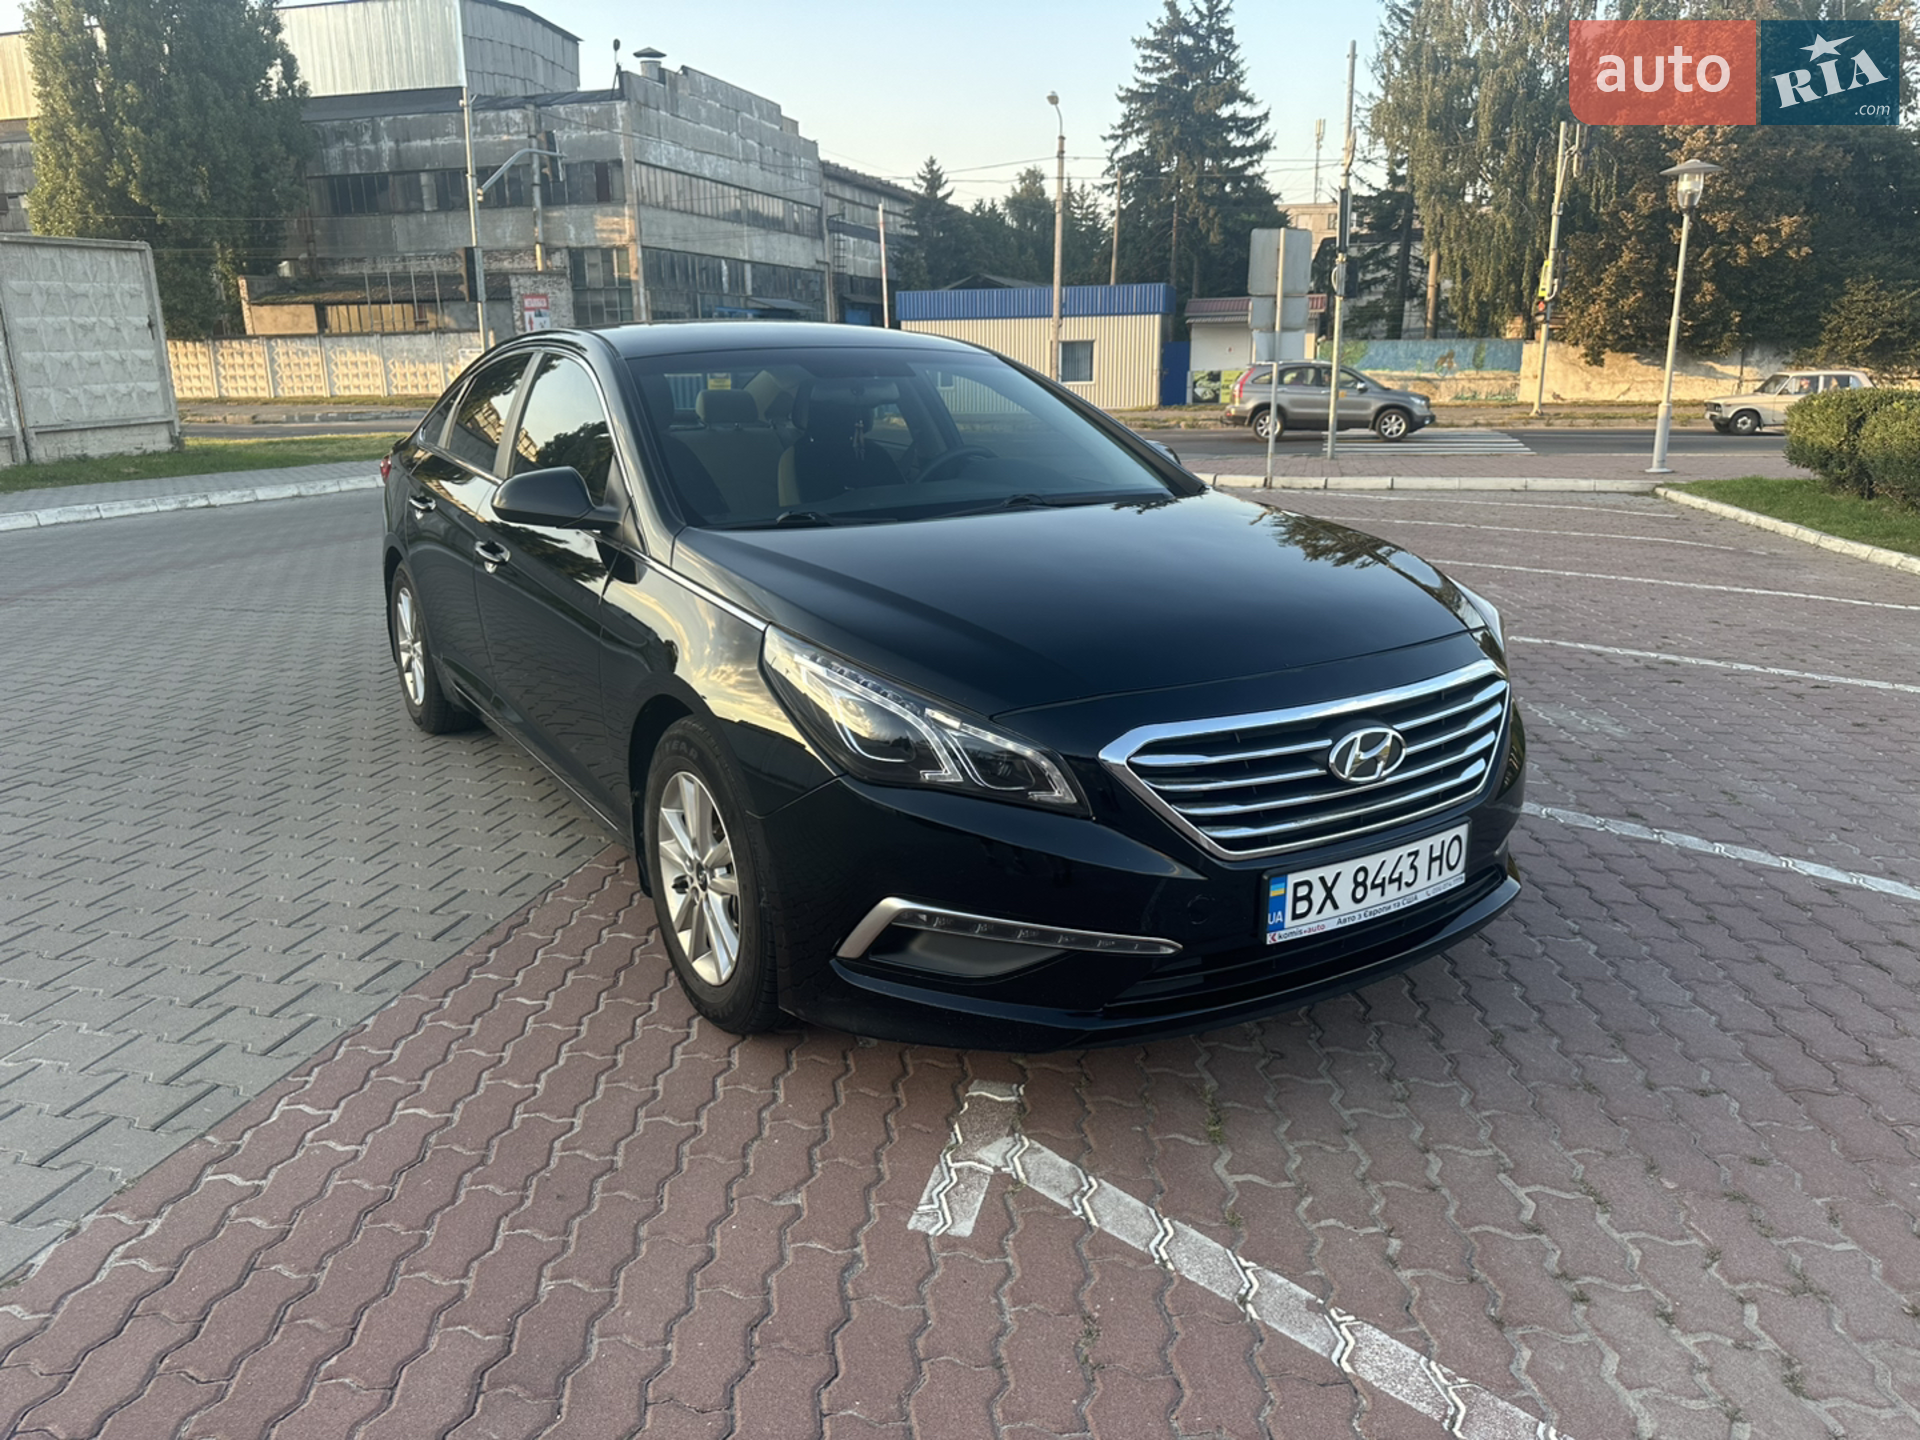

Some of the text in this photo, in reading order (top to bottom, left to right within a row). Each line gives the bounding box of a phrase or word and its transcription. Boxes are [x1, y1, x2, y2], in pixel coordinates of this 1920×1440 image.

[1291, 871, 1342, 921] BX
[1351, 849, 1420, 904] 8443
[1427, 834, 1463, 881] HO
[1268, 911, 1284, 925] UA
[1336, 915, 1357, 926] Авто
[1363, 904, 1392, 918] Європи
